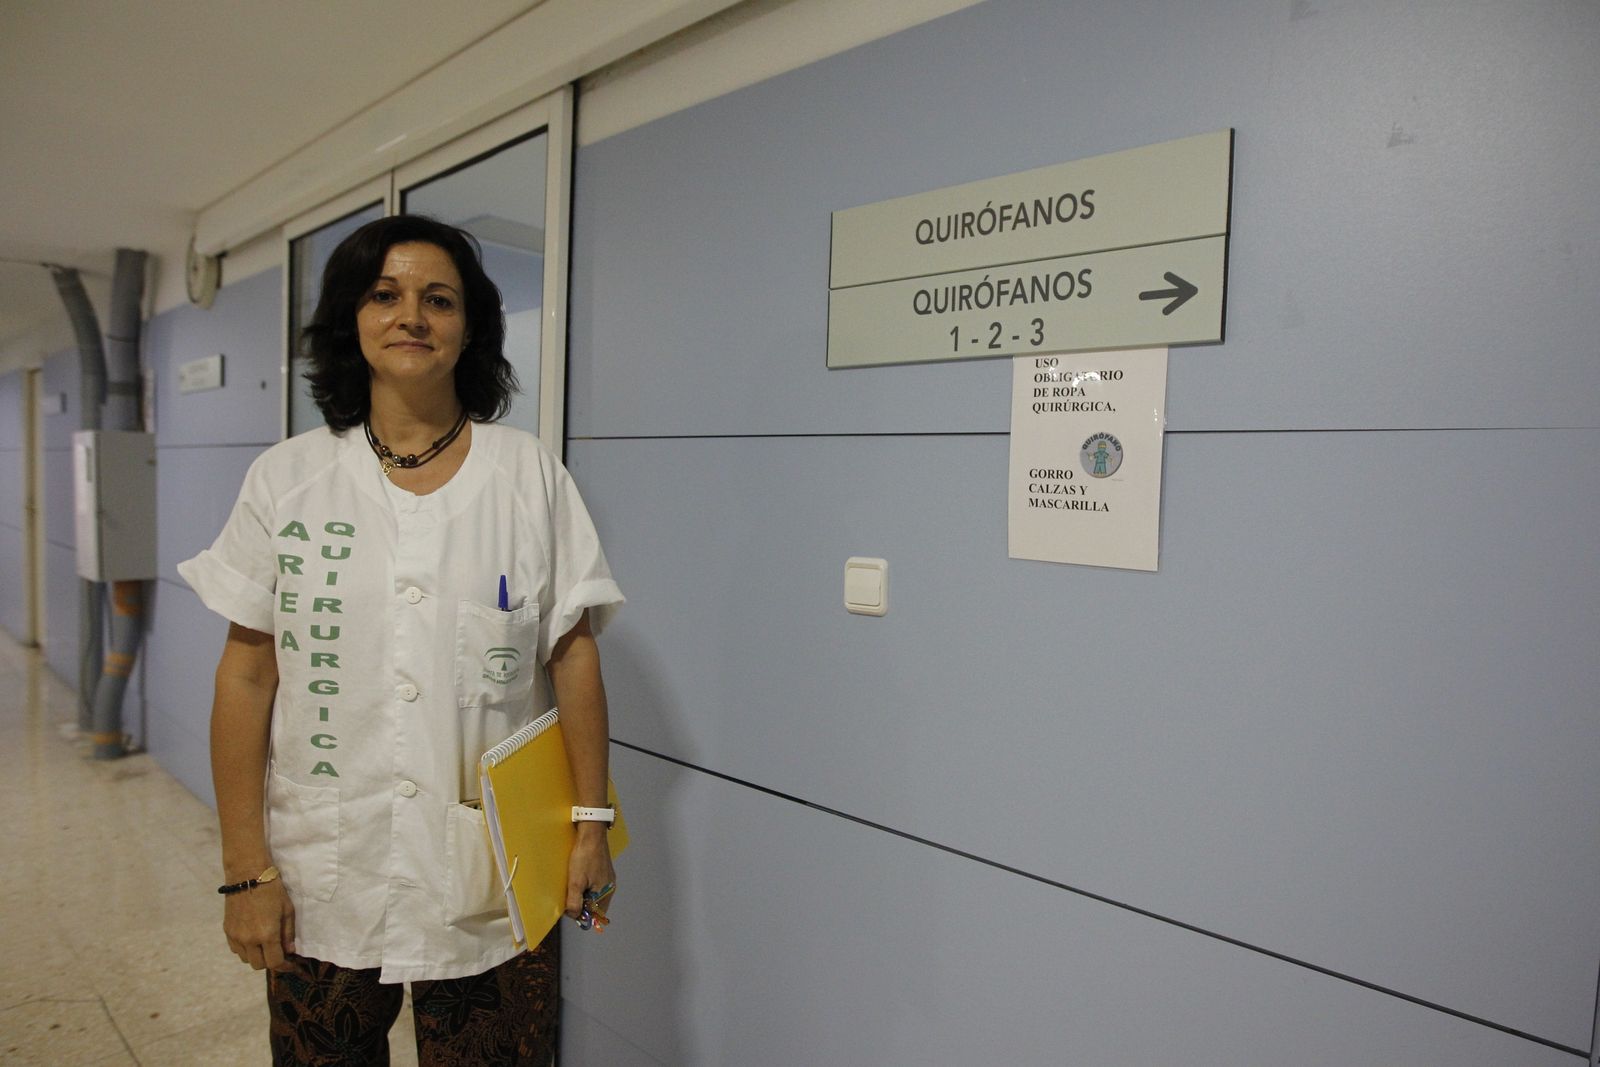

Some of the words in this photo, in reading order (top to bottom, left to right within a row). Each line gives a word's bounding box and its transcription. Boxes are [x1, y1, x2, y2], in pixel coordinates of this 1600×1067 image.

[915, 189, 1095, 245] QUIRÓFANOS
[913, 269, 1092, 315] QUIRÓFANOS
[950, 326, 959, 352] 1
[988, 322, 1002, 349] 2
[1030, 318, 1044, 346] 3
[1035, 357, 1059, 369] USO
[1033, 387, 1049, 398] DE
[1052, 386, 1086, 397] ROPA
[1032, 399, 1116, 415] QUIRÚRGICA,
[1029, 469, 1073, 480] GORRO
[1028, 483, 1076, 495] CALZAS
[1079, 485, 1088, 495] Y
[1028, 498, 1109, 512] MASCARILLA
